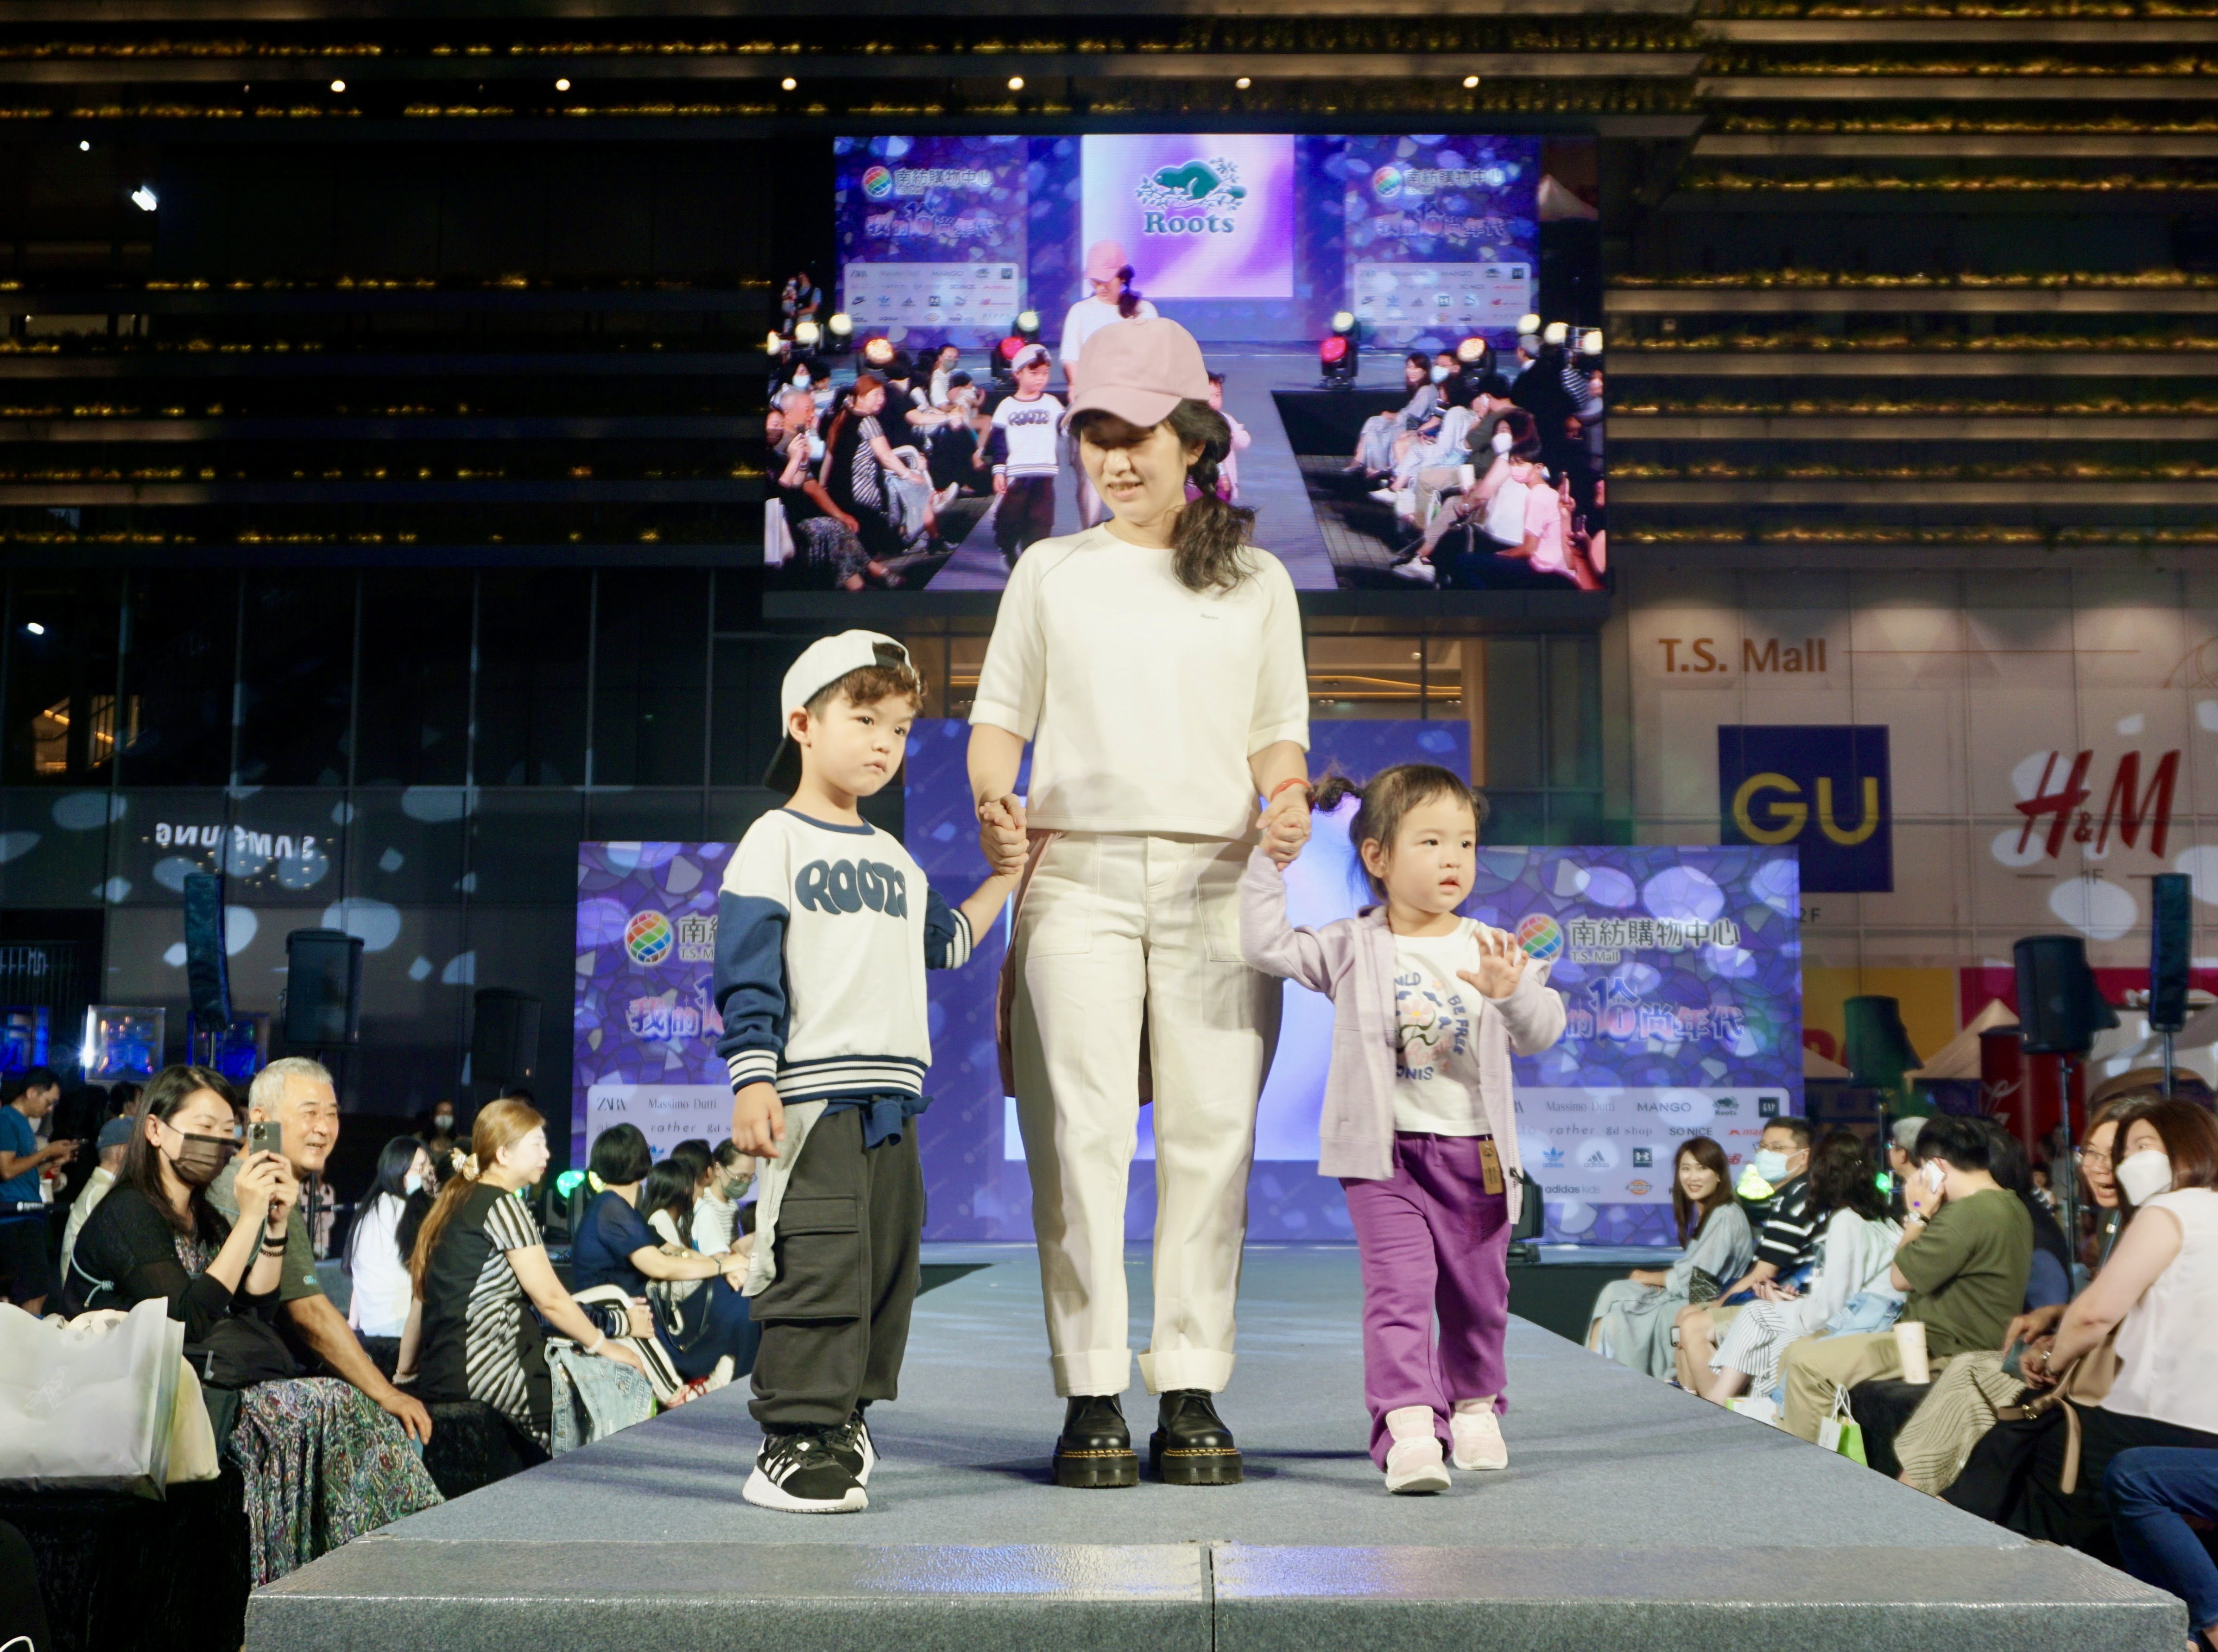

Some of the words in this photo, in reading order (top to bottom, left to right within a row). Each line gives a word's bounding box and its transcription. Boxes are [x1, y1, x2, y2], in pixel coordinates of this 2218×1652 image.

[1144, 212, 1235, 233] Roots
[1658, 637, 1728, 672] T.S.
[1743, 637, 1826, 672] Mall
[1733, 772, 1879, 845] GU
[2014, 748, 2181, 859] H&M
[795, 858, 908, 920] ROOTS
[1570, 919, 1739, 946] 南紡購物中心
[681, 948, 699, 959] T.S.
[1572, 951, 1591, 962] T.S.
[1594, 951, 1618, 962] Mall
[1448, 994, 1466, 1015] BE
[1453, 1019, 1469, 1055] FREE
[597, 1097, 626, 1111] ZARA
[648, 1098, 689, 1109] Massimo
[694, 1098, 717, 1109] Dutti
[1546, 1100, 1587, 1112] Massimo
[1592, 1101, 1615, 1112] Dutti
[1637, 1102, 1692, 1112] MANGO
[1763, 1103, 1776, 1112] GAP
[651, 1120, 695, 1133] rather
[707, 1124, 720, 1133] gd
[1550, 1123, 1595, 1134] rather
[1606, 1127, 1619, 1135] gd
[1625, 1127, 1652, 1137] shop
[1669, 1127, 1685, 1136] SO
[1687, 1127, 1713, 1136] NICE
[1545, 1185, 1580, 1193] adidas
[1582, 1185, 1600, 1193] kids
